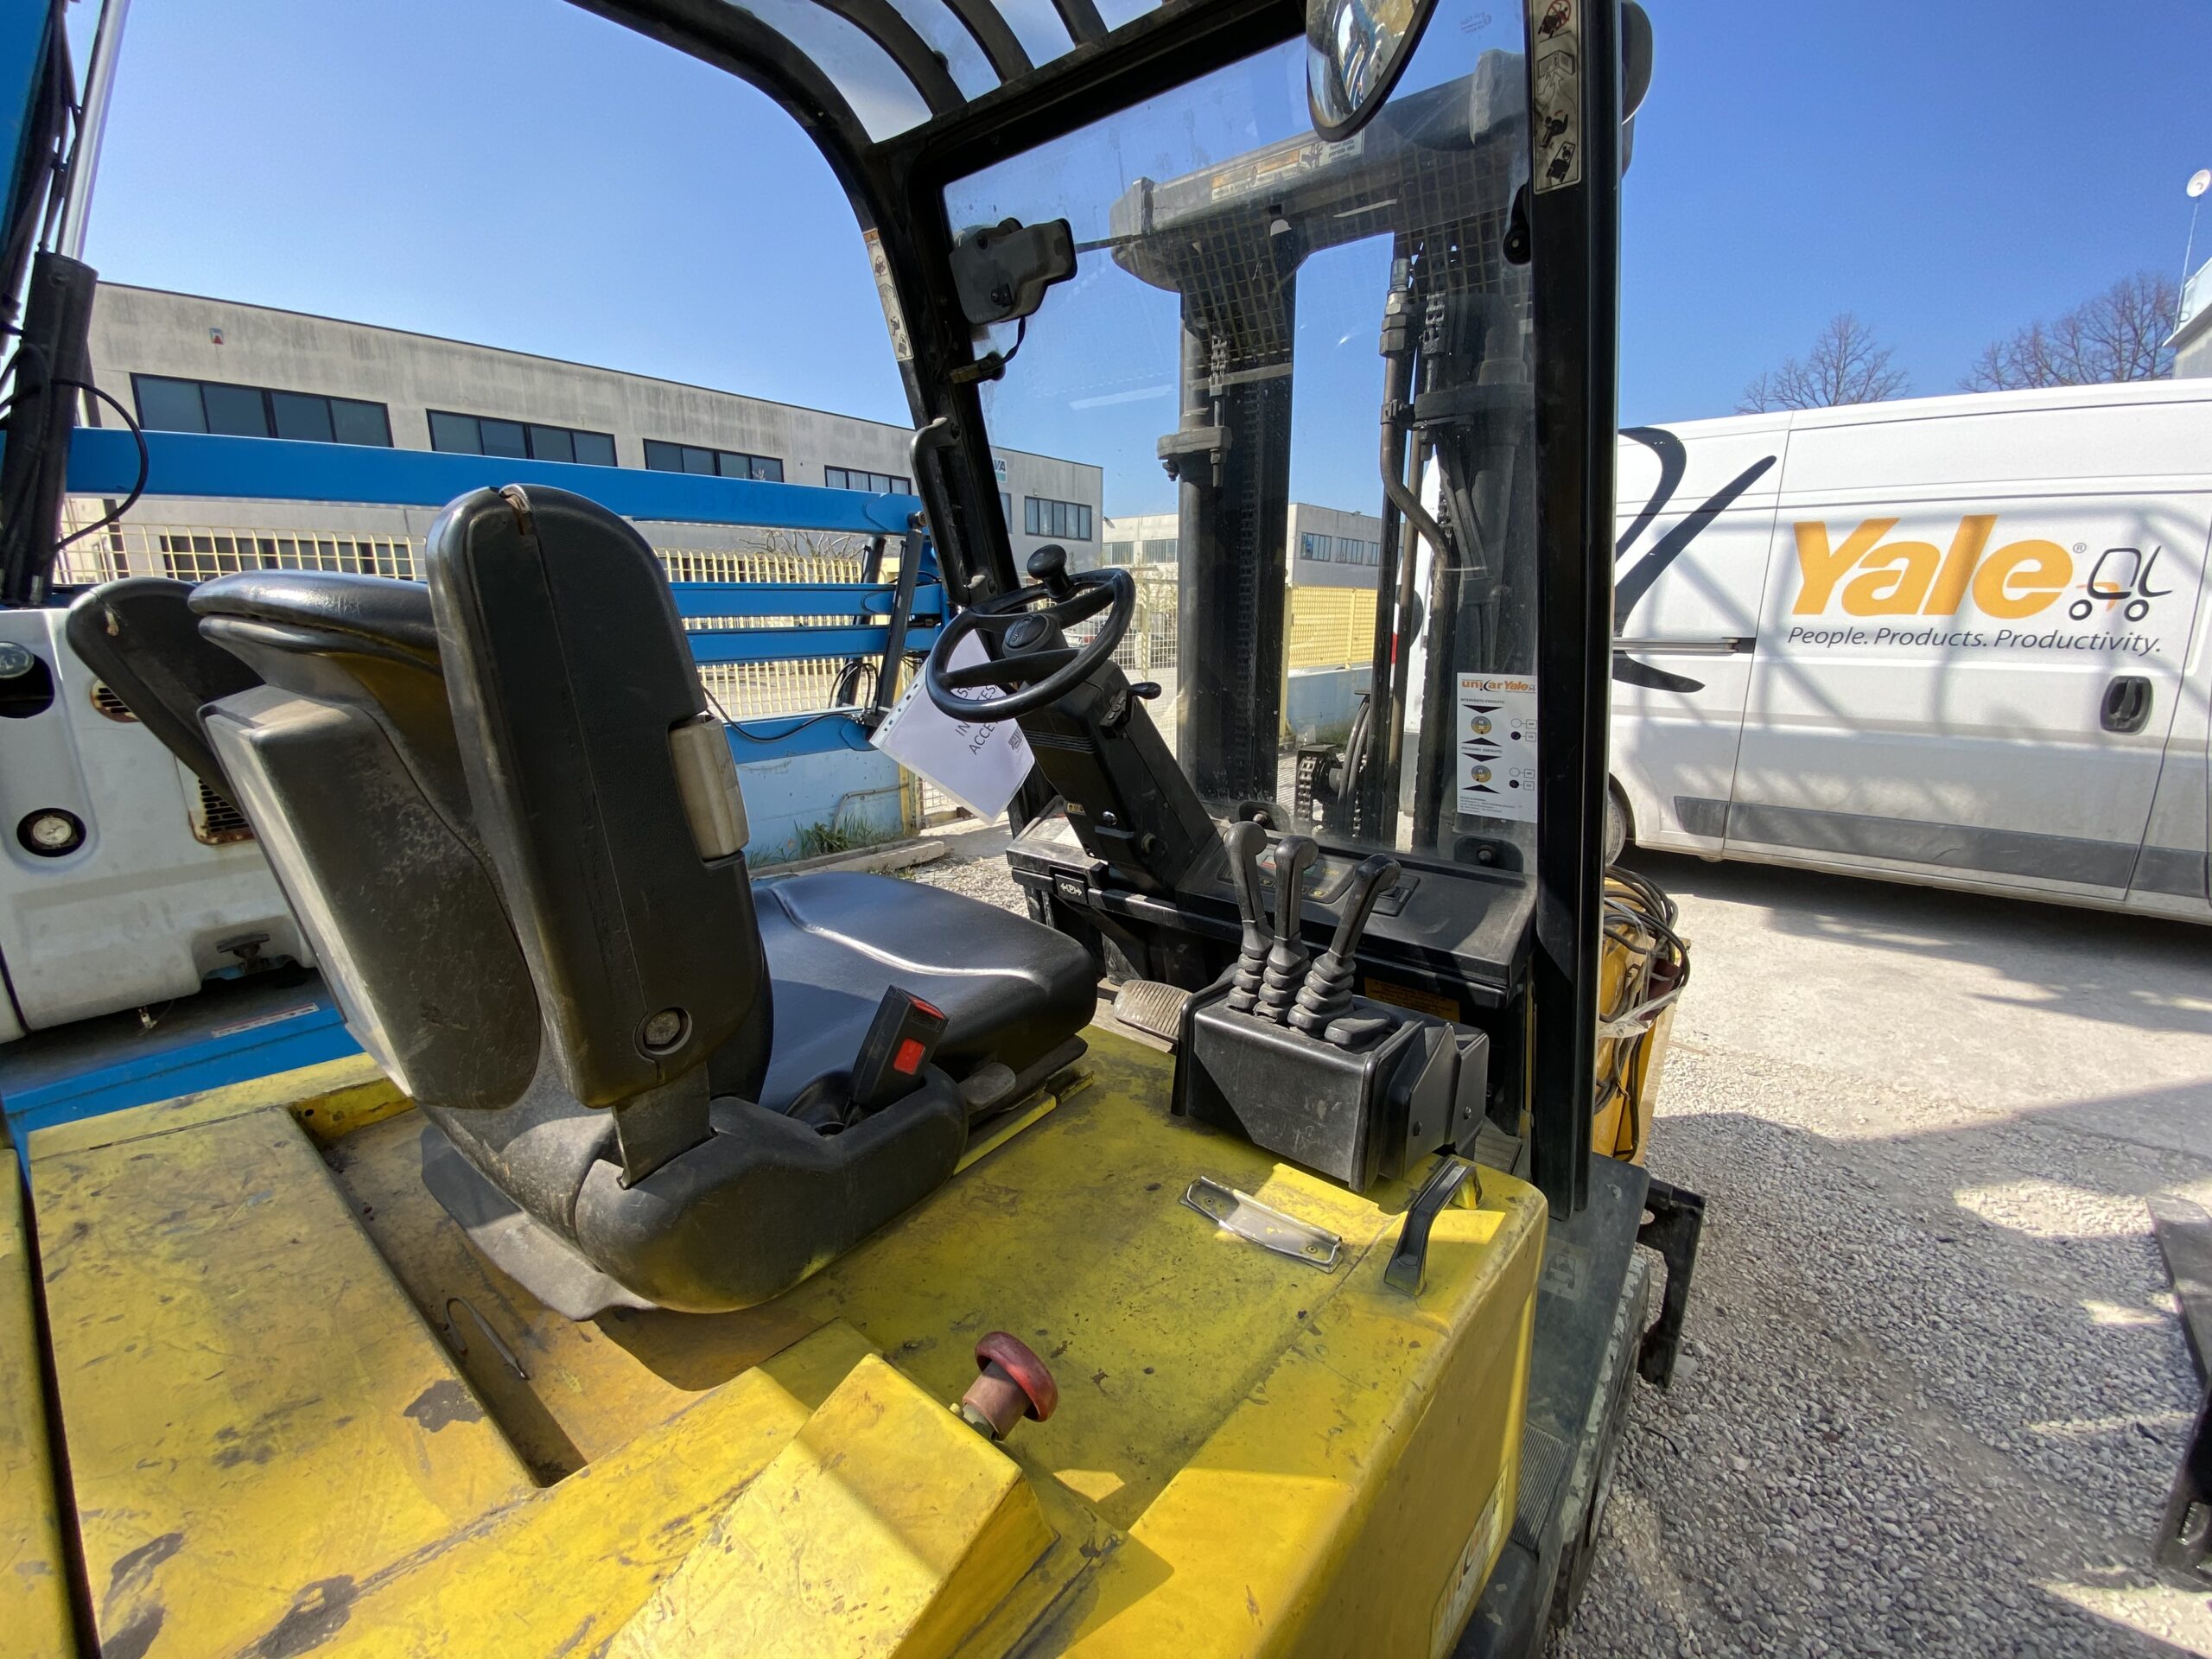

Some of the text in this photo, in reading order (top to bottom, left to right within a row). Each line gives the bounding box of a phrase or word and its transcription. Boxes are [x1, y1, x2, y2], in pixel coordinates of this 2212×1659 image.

[1792, 514, 2074, 619] Yale
[1788, 626, 2162, 658] People. Products. Productivity.
[969, 721, 999, 755] ACCE
